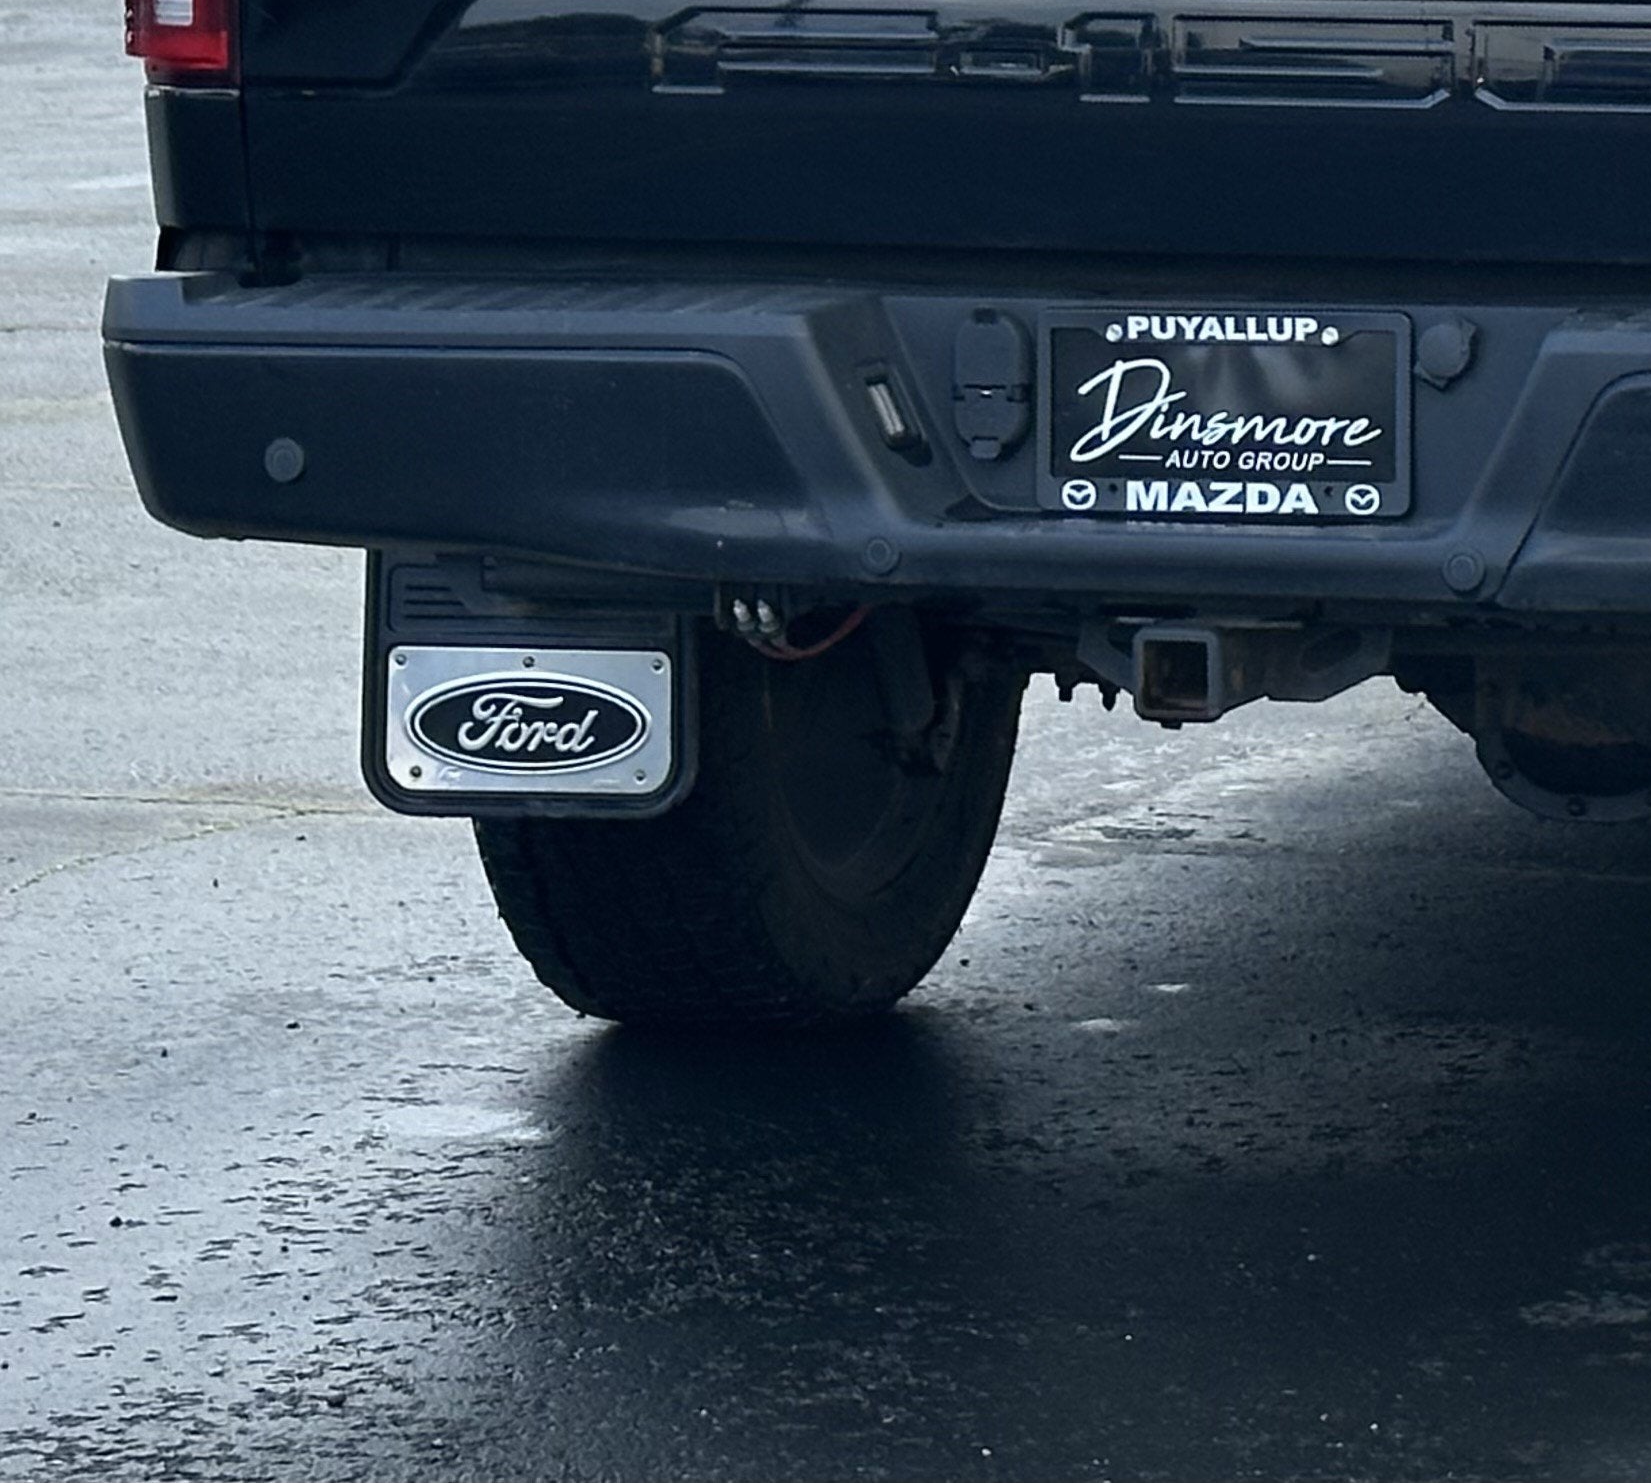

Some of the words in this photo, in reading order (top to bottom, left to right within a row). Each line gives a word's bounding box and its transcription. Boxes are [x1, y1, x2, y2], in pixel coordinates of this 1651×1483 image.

[1127, 315, 1318, 342] PUYALLUP
[1070, 358, 1382, 462] Dinsmore
[1165, 449, 1231, 470] AUTO
[1238, 451, 1325, 472] GROUP
[1125, 479, 1319, 515] MAZDA
[458, 692, 599, 752] Ford
